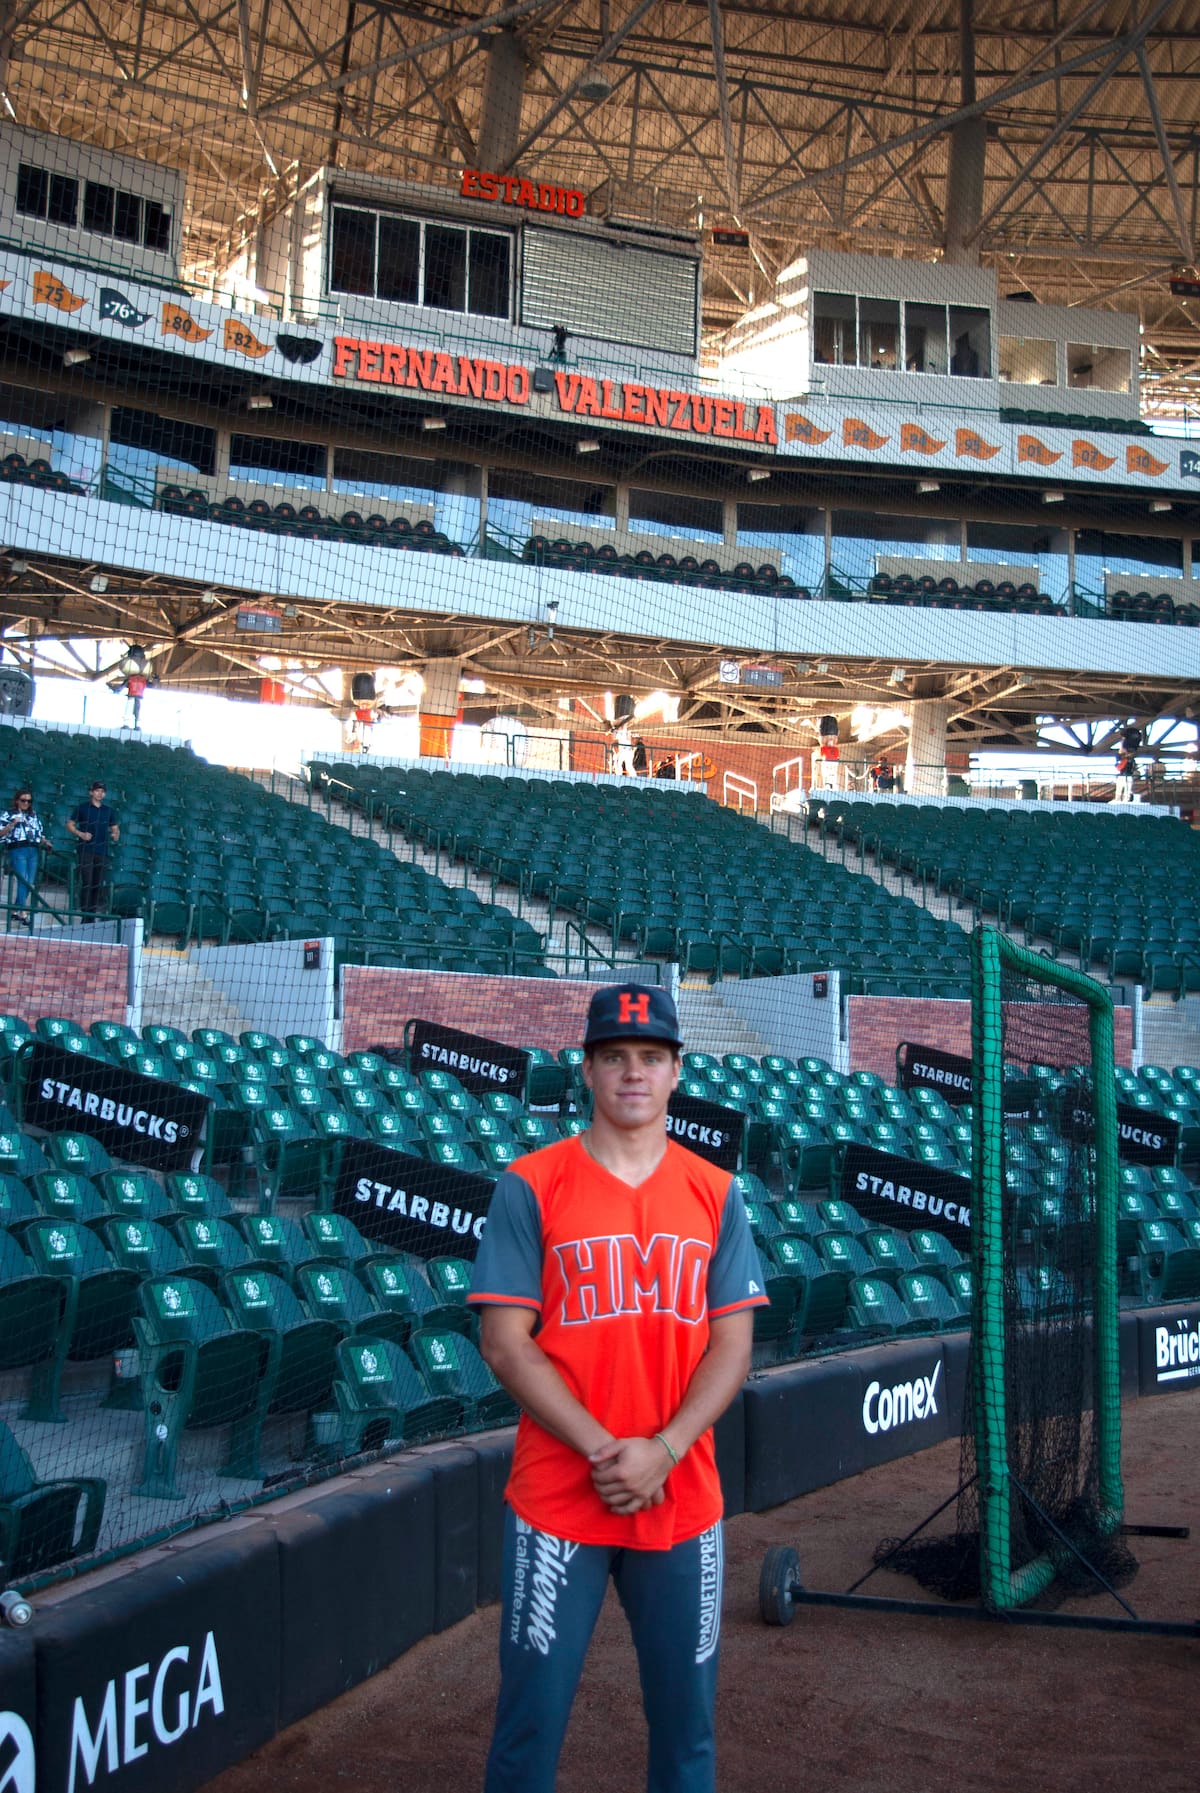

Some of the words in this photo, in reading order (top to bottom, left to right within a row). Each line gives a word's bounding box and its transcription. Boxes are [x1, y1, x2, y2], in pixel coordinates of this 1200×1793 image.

[462, 169, 585, 218] ESTADIO
[333, 336, 529, 404] FERNANDO
[554, 371, 778, 445] VALENZUELA
[618, 992, 650, 1024] H
[912, 1062, 973, 1092] STARBUC
[1117, 1122, 1161, 1150] UCKS
[552, 1233, 712, 1326] HMO
[1156, 1319, 1200, 1368] Brüc
[863, 1360, 941, 1434] Comex
[510, 1534, 530, 1644] caliente.mx
[527, 1530, 579, 1656] aliente
[67, 1630, 225, 1793] MEGA
